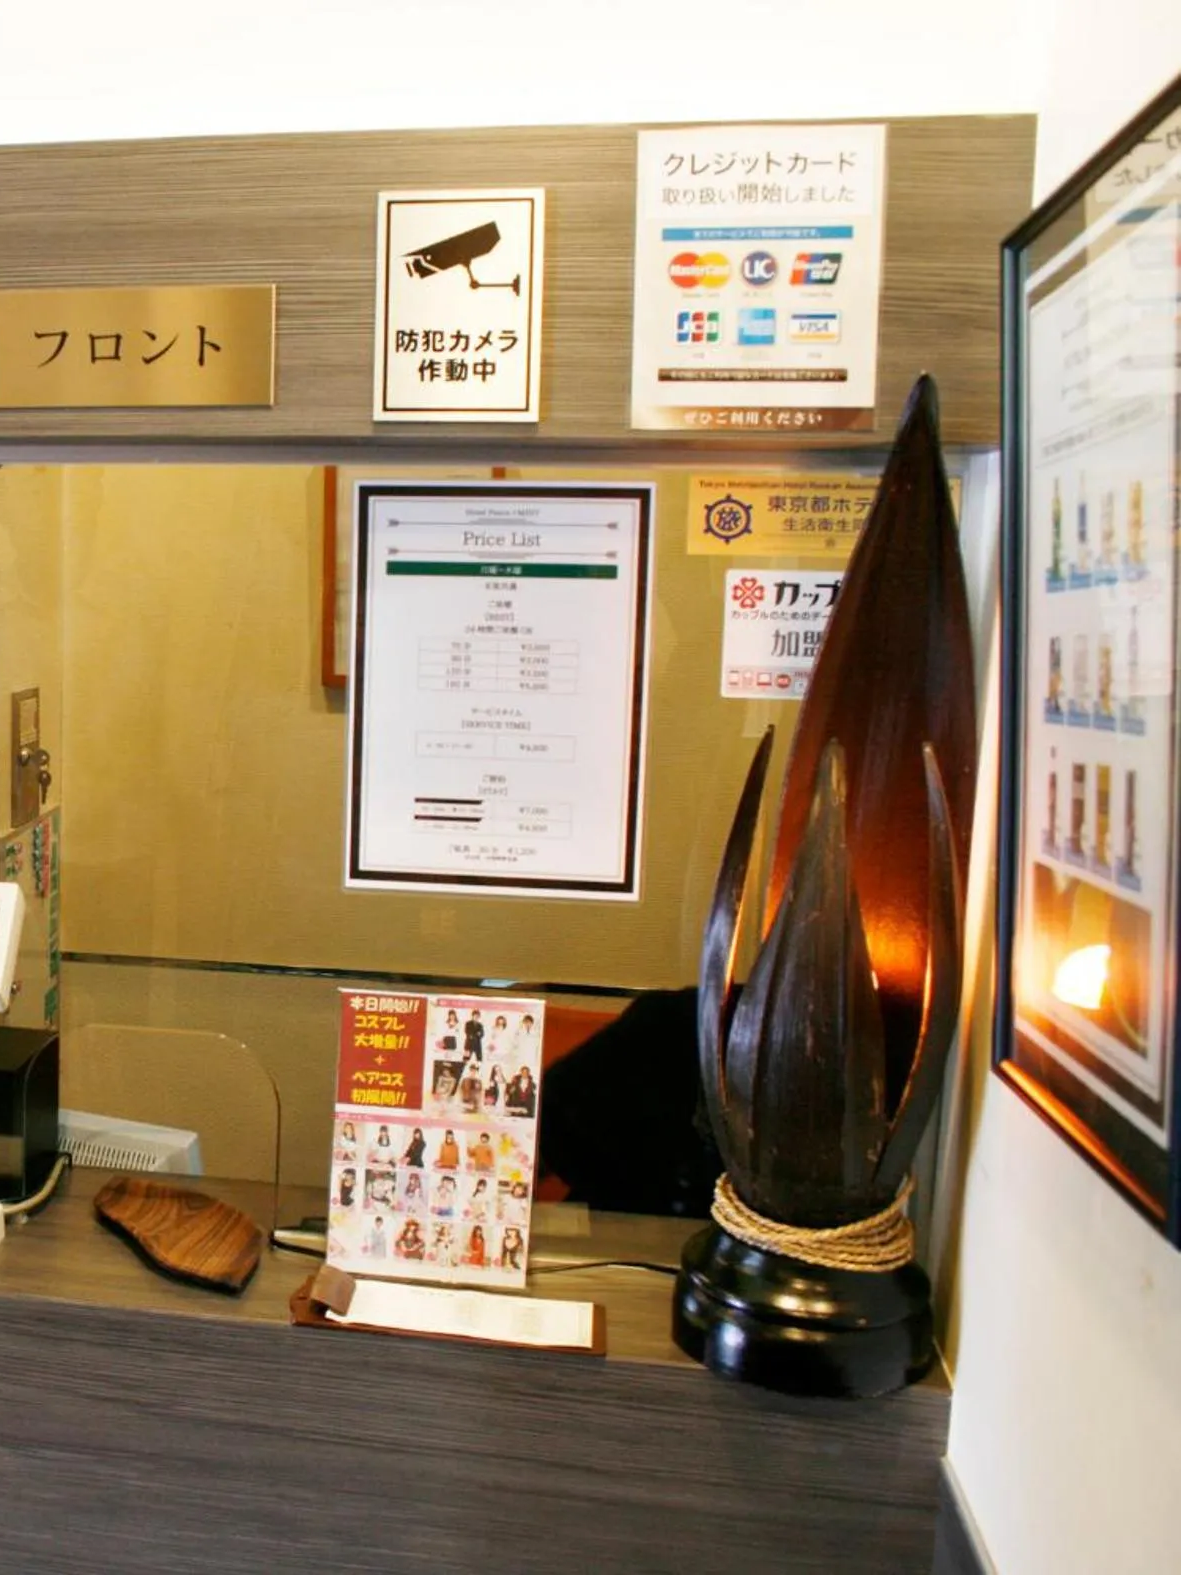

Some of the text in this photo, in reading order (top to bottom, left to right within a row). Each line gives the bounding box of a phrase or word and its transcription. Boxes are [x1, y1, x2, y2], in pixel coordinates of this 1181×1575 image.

[663, 151, 857, 176] クレジットカード
[662, 182, 856, 206] 取り扱い開始しました
[743, 259, 775, 279] UC
[798, 321, 830, 333] VISA
[34, 325, 221, 368] フロント
[395, 329, 519, 353] 防犯カメラ
[418, 358, 497, 382] 作動中
[684, 410, 823, 425] ぜひご利用ください
[462, 530, 541, 547] Price List
